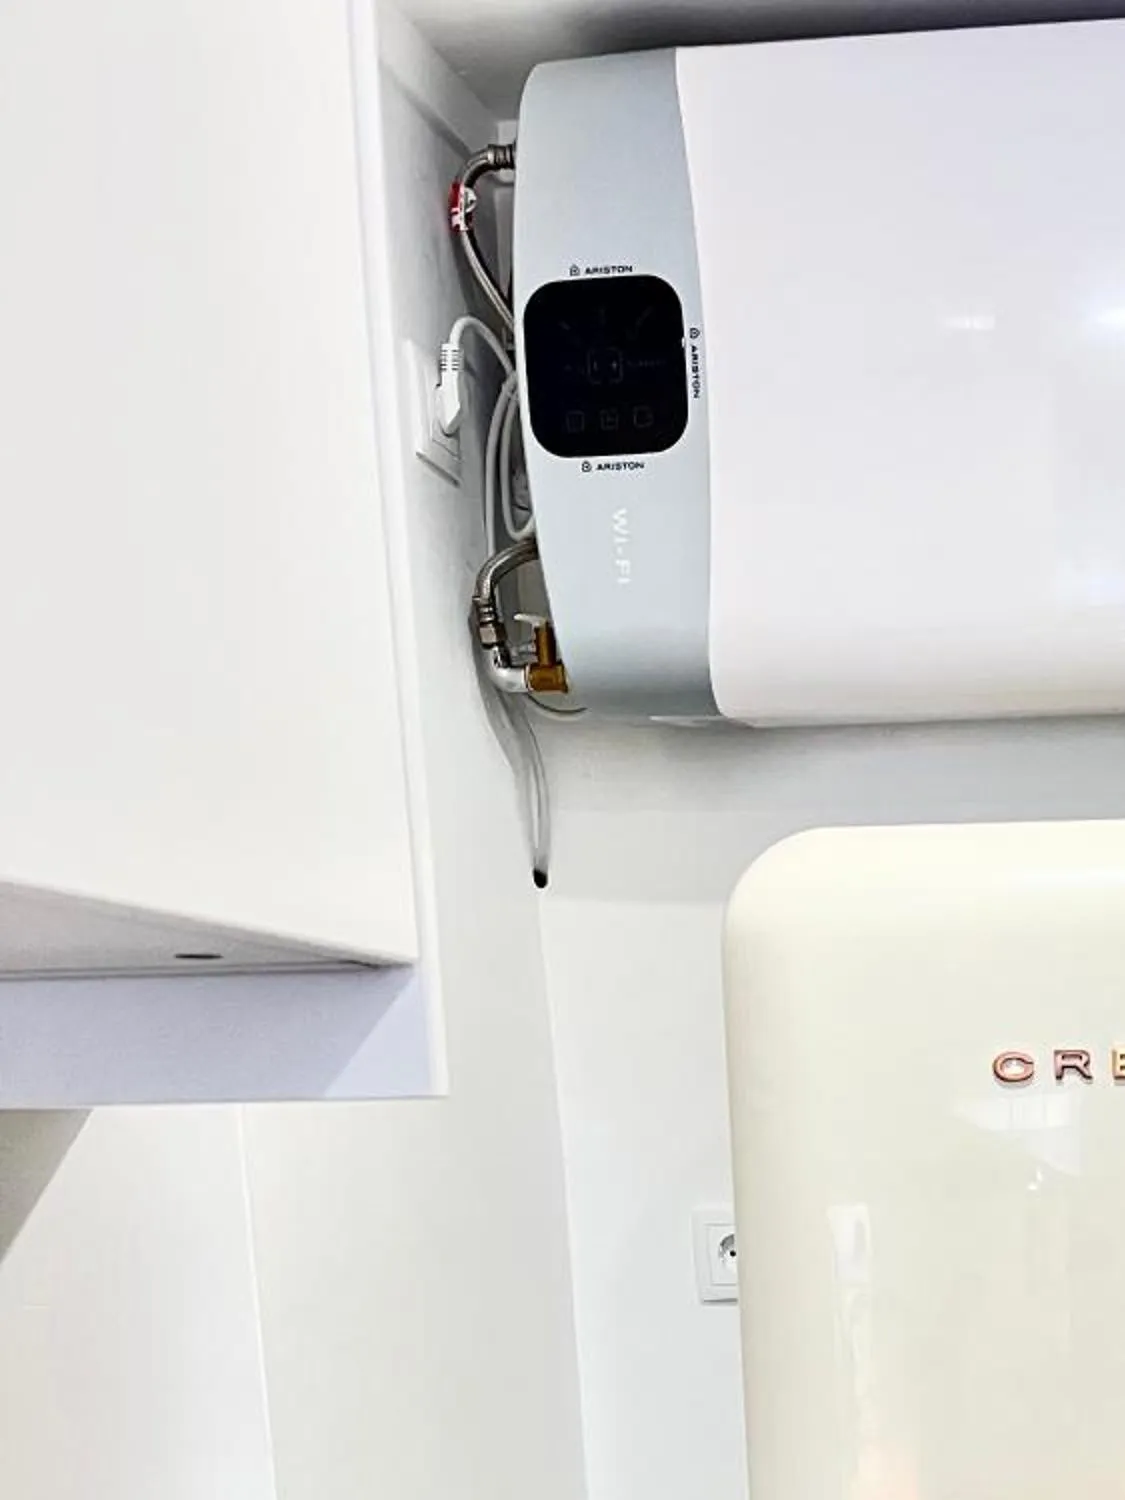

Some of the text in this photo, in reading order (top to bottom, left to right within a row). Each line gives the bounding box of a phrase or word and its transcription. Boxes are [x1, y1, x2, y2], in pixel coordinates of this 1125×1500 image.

[585, 265, 633, 275] ARISTON
[690, 344, 700, 399] ARISTON
[596, 462, 645, 471] ARISTON
